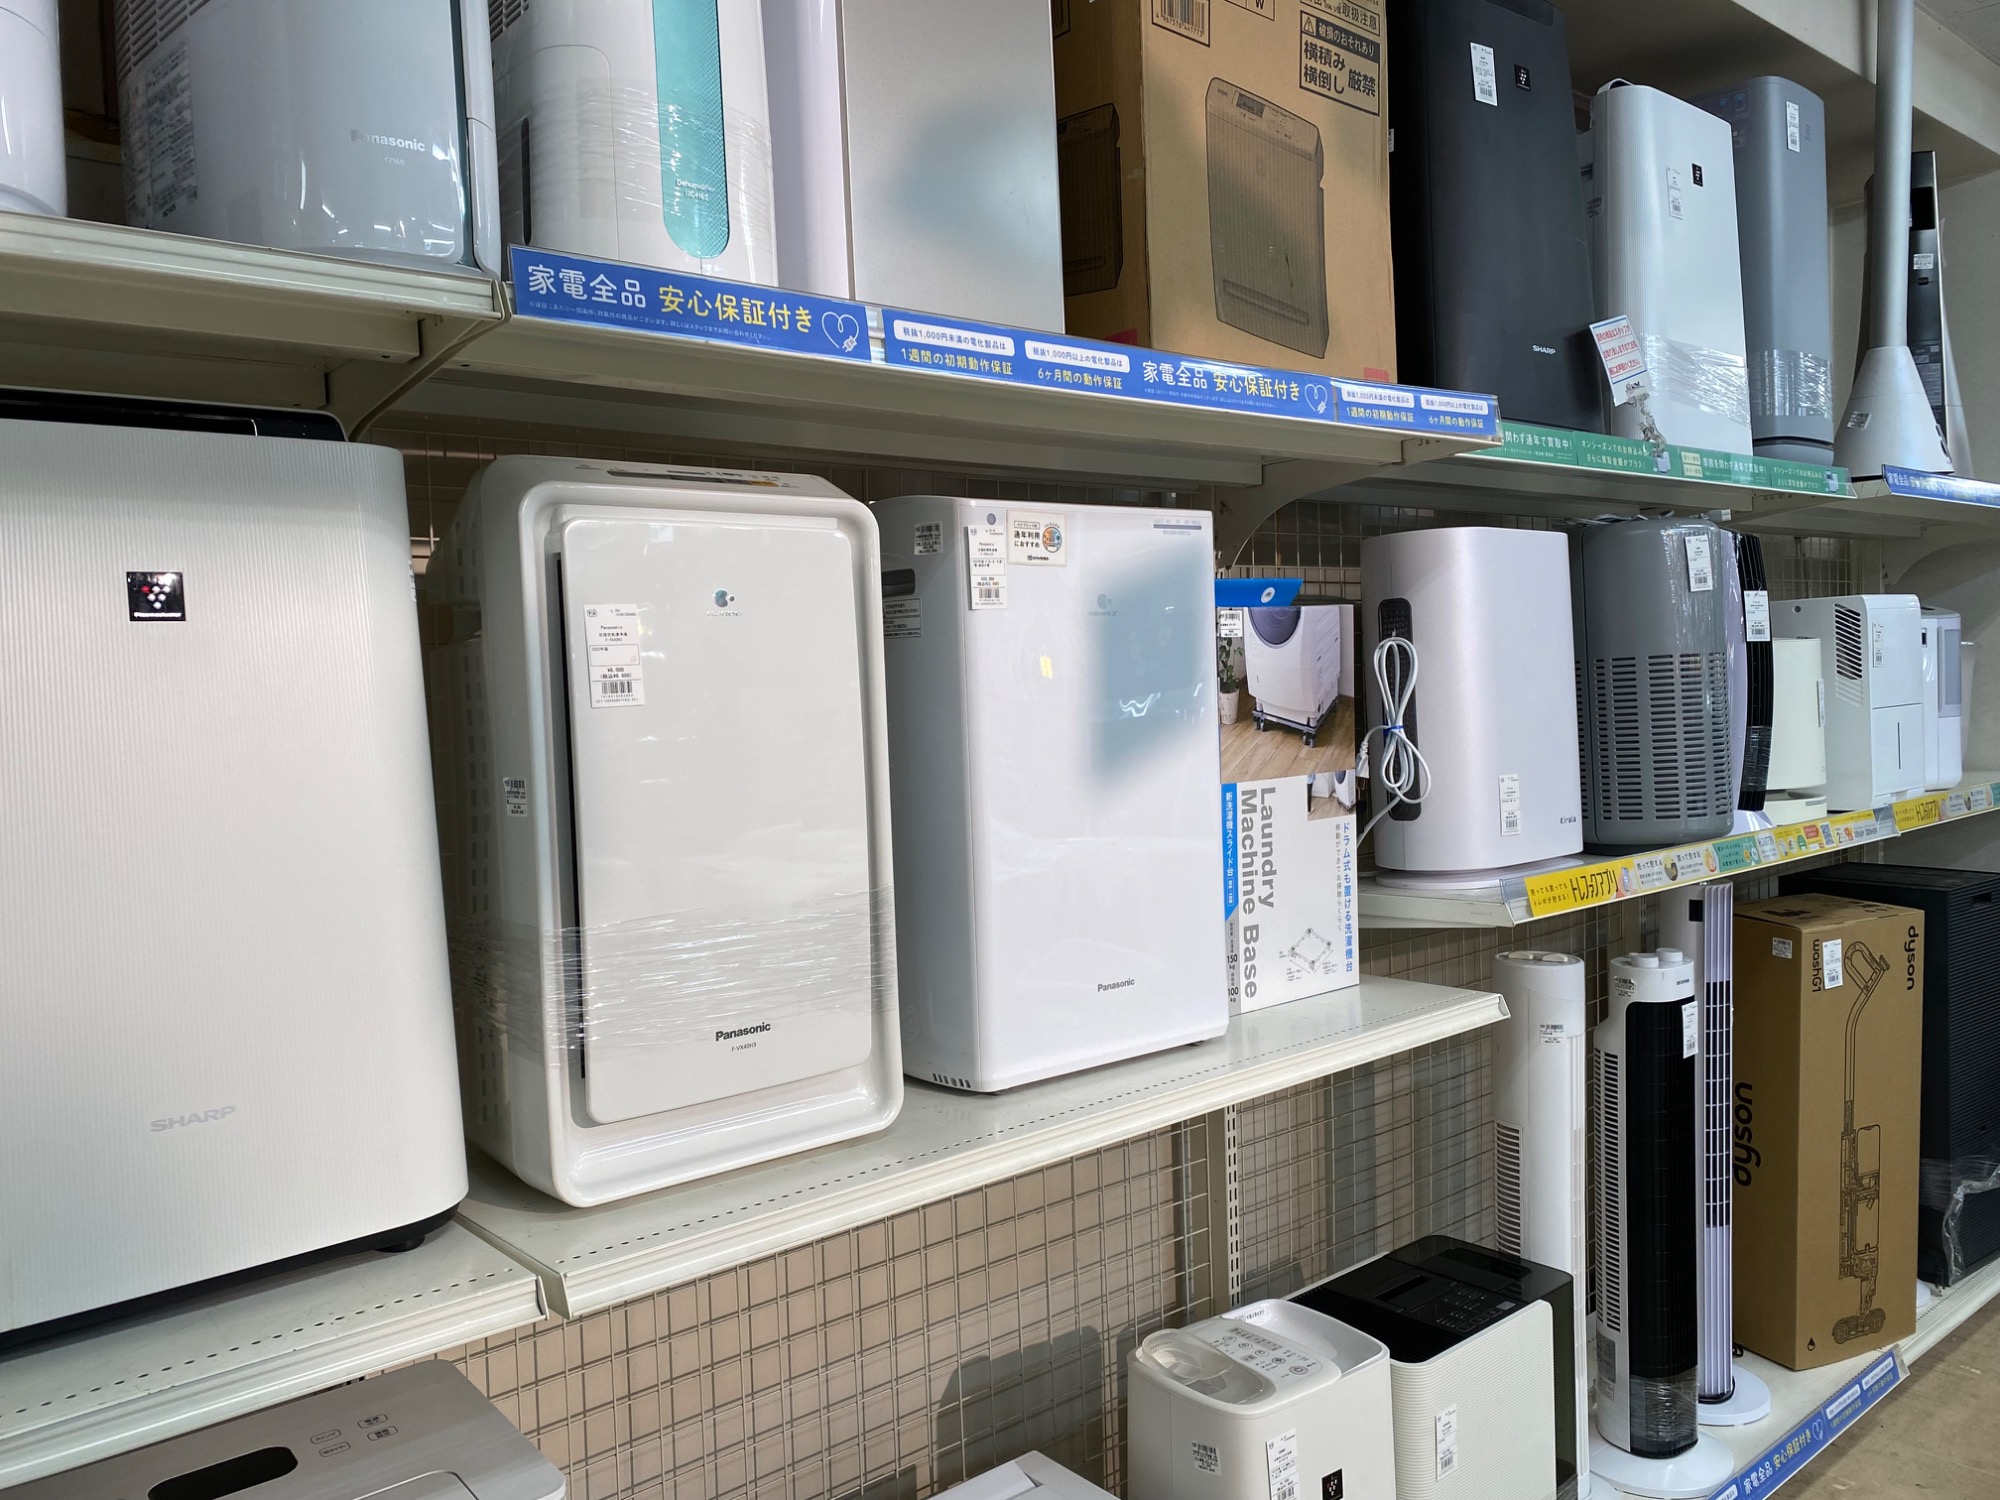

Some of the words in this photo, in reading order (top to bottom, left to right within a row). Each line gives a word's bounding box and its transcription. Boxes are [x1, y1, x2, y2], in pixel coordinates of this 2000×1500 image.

[1318, 22, 1375, 57] 破損のおそれあり
[1304, 40, 1346, 71] 横積み
[1304, 63, 1345, 94] 横倒し
[1348, 69, 1377, 97] 厳禁
[351, 129, 427, 153] Panasonic
[527, 264, 647, 309] 家電全品
[658, 285, 814, 334] 安心保証付き
[903, 326, 1007, 351] 税抜1,000円未満の電化製品は
[1532, 344, 1557, 355] SHARP
[901, 348, 1013, 376] 1週間の初期動作保証
[1033, 346, 1123, 369] 税抜1,000円以上の電化製品は
[1142, 360, 1208, 390] 家電全品
[1213, 370, 1301, 402] 安心保証付き
[1346, 407, 1415, 424] 1週間の初期動作保証
[1014, 530, 1040, 540] 通年利用
[1014, 540, 1040, 548] におすすめ
[1241, 789, 1258, 915] Machine
[1258, 787, 1277, 909] Laundry
[1343, 821, 1352, 973] ドラム式も置ける洗濯機台
[1570, 869, 1619, 903] トレファクアプリ
[1227, 953, 1238, 964] 150
[1243, 924, 1259, 999] Base
[1812, 939, 1822, 993] washG1
[1904, 925, 1919, 991] dyson
[1097, 977, 1135, 993] Panasonic
[1228, 986, 1239, 997] 100
[715, 1022, 771, 1042] Panasonic
[150, 1105, 236, 1132] SHARP
[1733, 1082, 1762, 1187] dyson
[1743, 1461, 1774, 1495] 家電全品
[1773, 1428, 1813, 1471] 安心保証付き
